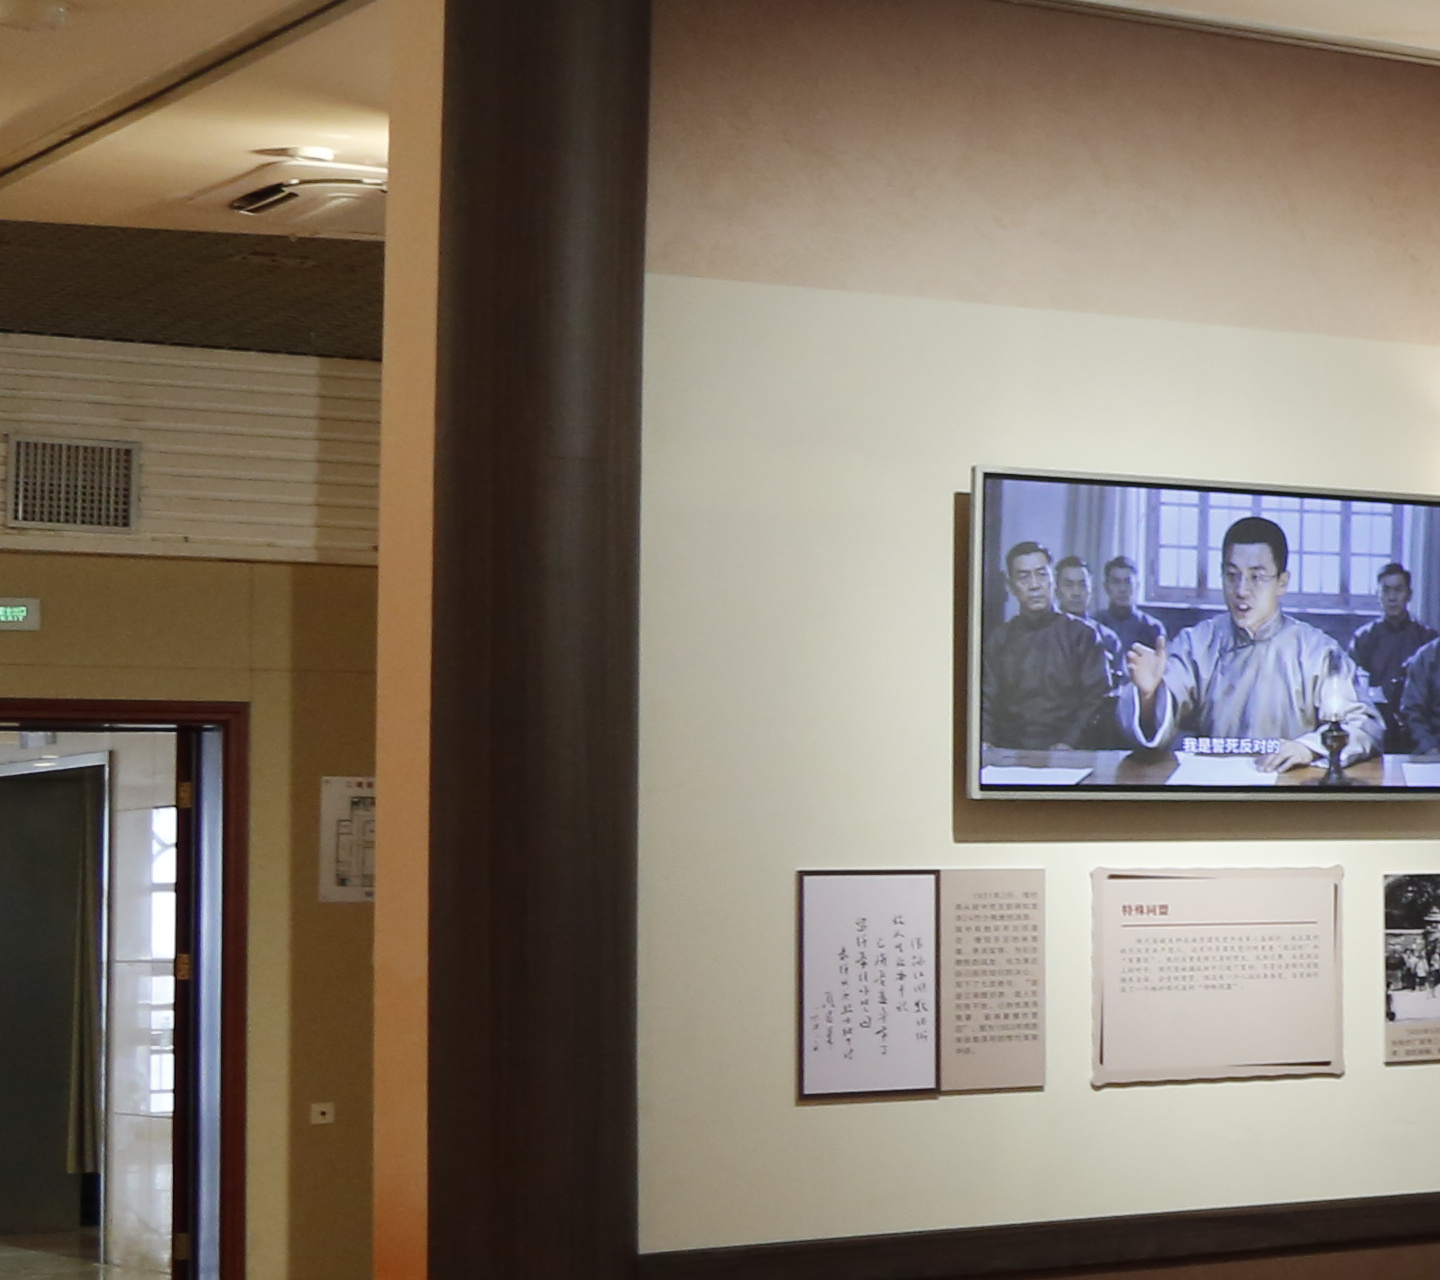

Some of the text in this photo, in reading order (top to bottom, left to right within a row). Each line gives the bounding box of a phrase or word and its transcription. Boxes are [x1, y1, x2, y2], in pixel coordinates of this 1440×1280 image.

[1182, 737, 1280, 754] 我是誓死反对的
